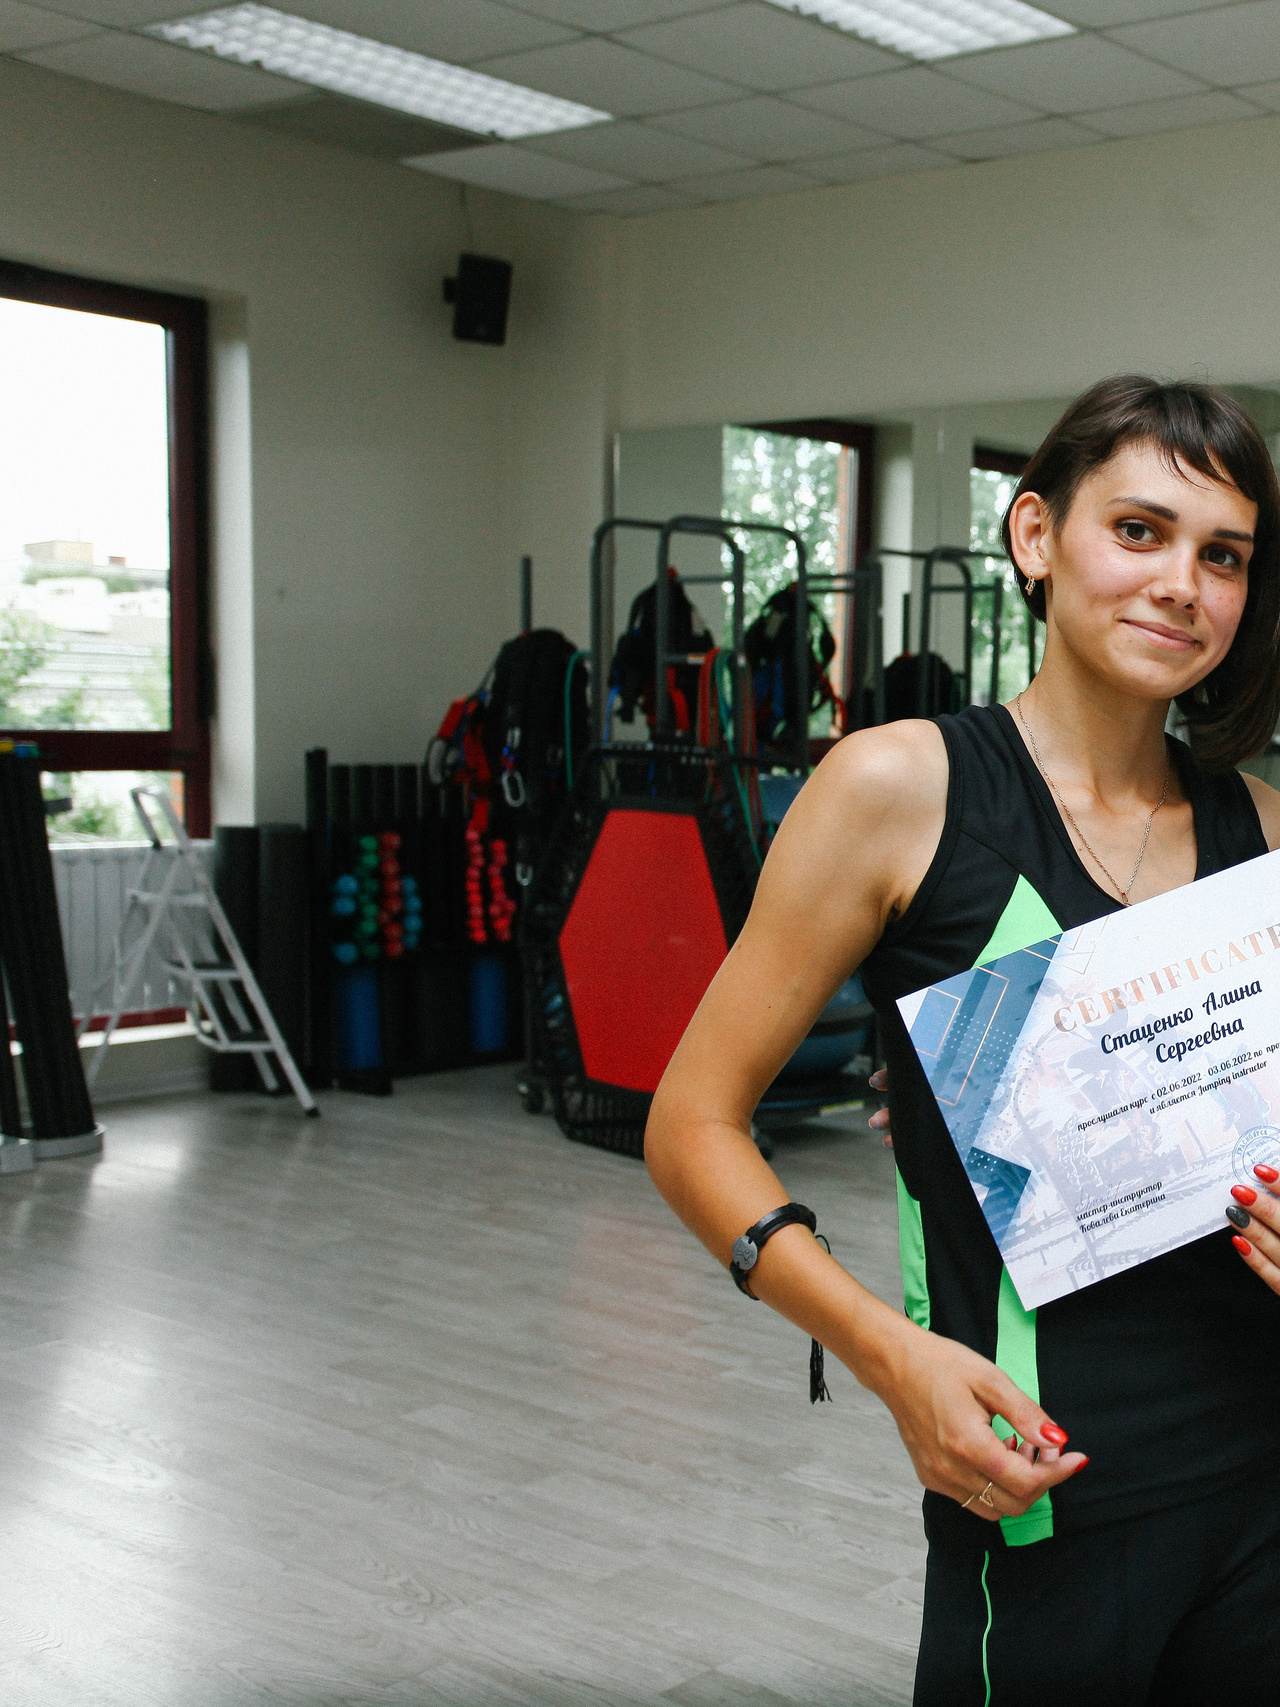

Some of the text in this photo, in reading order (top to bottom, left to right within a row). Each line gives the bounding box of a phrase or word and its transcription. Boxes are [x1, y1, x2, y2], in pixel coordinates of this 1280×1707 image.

[1101, 980, 1263, 1055] Стаценко Алина
[1155, 1018, 1245, 1064] Сергеевна
[1077, 1105, 1129, 1132] прослушала
[1129, 1096, 1149, 1111] курс
[1156, 1072, 1203, 1099] 02.06.2022
[1207, 1051, 1253, 1077] 03.06.2022
[1253, 1049, 1263, 1059] по
[1156, 1089, 1197, 1111] является
[1197, 1074, 1231, 1097] Jumping
[1231, 1060, 1268, 1080] instructor
[1075, 1181, 1163, 1223] мастер-инструктор
[1079, 1212, 1120, 1234] Ковалева
[1120, 1193, 1166, 1217] Екатерина
